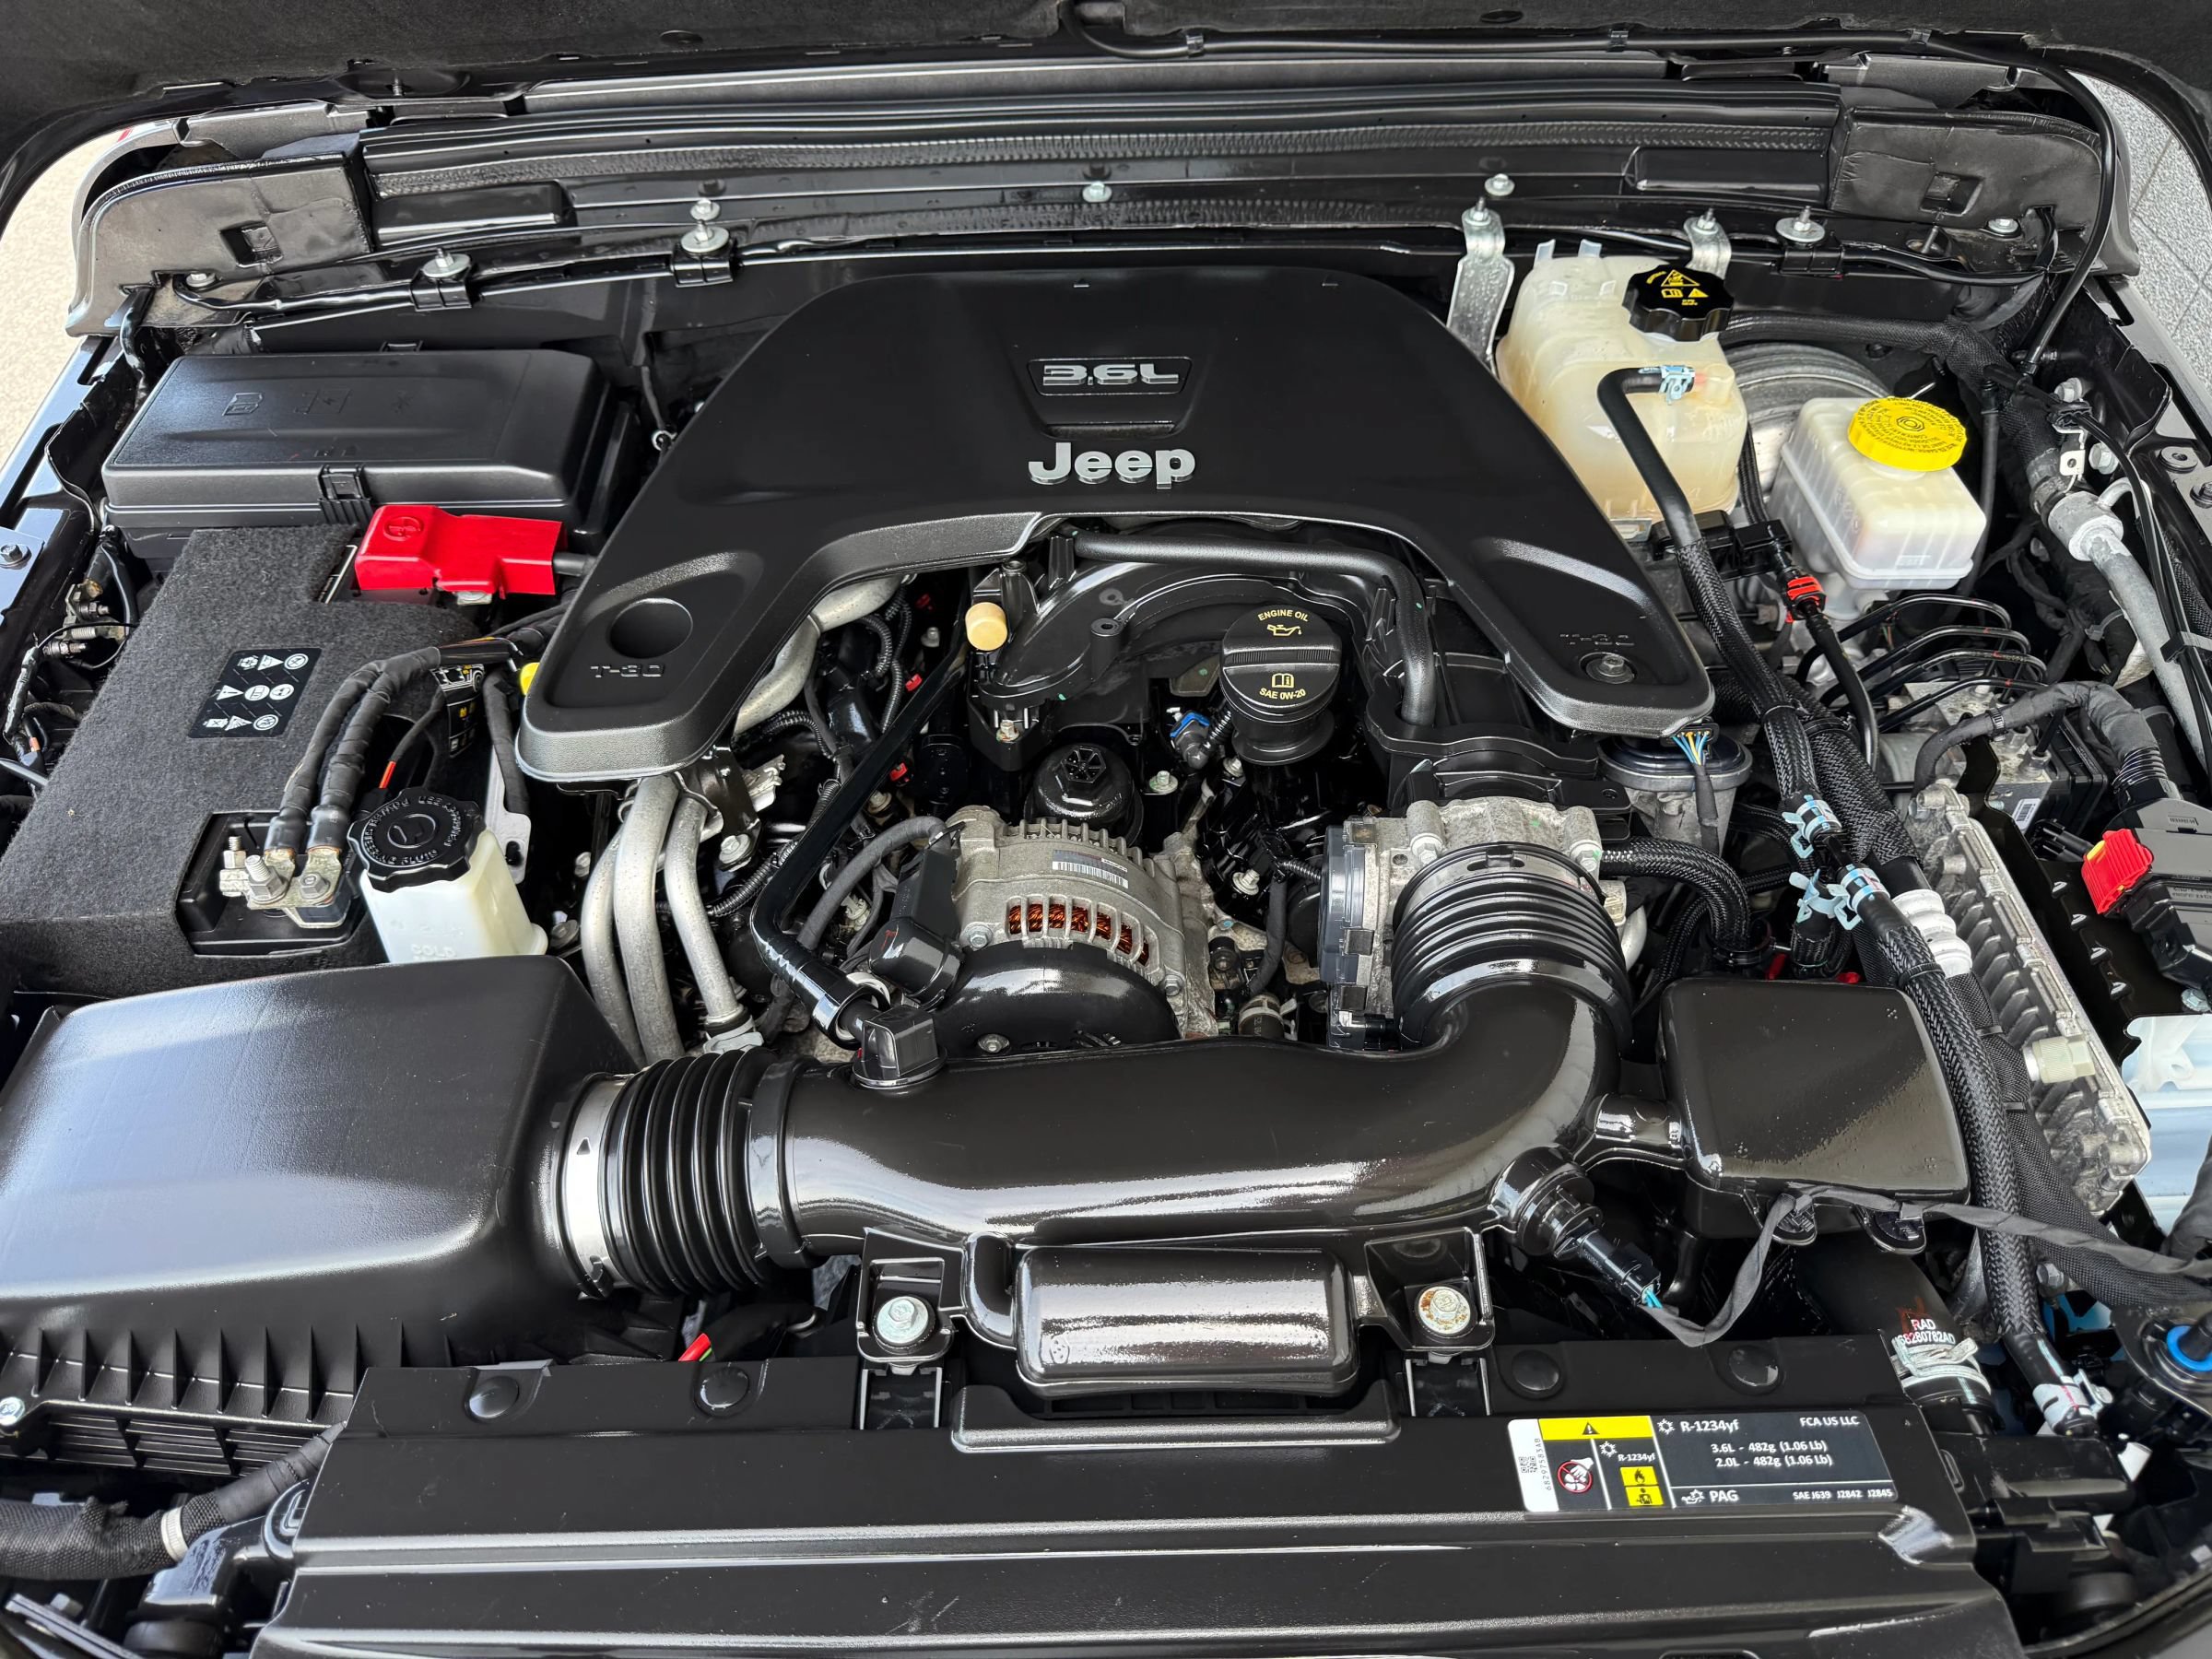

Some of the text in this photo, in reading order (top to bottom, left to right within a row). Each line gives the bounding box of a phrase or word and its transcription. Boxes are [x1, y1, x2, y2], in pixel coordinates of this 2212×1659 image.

[1042, 362, 1179, 386] 3.6L
[1028, 441, 1195, 489] Jeep
[1258, 609, 1309, 622] ENGINE OIL
[1259, 688, 1307, 700] SAE 0W-20
[1911, 1318, 1936, 1331] RAD
[1897, 1331, 1957, 1346] 68280782AD
[1680, 1418, 1740, 1434] R-1234yf
[1799, 1415, 1861, 1427] FCA US LLC
[1711, 1442, 1735, 1453] 3.6L
[1748, 1441, 1777, 1453] 482g
[1779, 1441, 1808, 1453] (1.06
[1808, 1440, 1828, 1452] Lb)
[1618, 1453, 1656, 1463] R-1234yf
[1714, 1457, 1740, 1467] 2.0L
[1753, 1455, 1783, 1467] 482g
[1784, 1454, 1813, 1467] (1.06
[1814, 1453, 1833, 1466] Lb)
[1709, 1489, 1740, 1502] PAG
[1792, 1491, 1811, 1500] SAE
